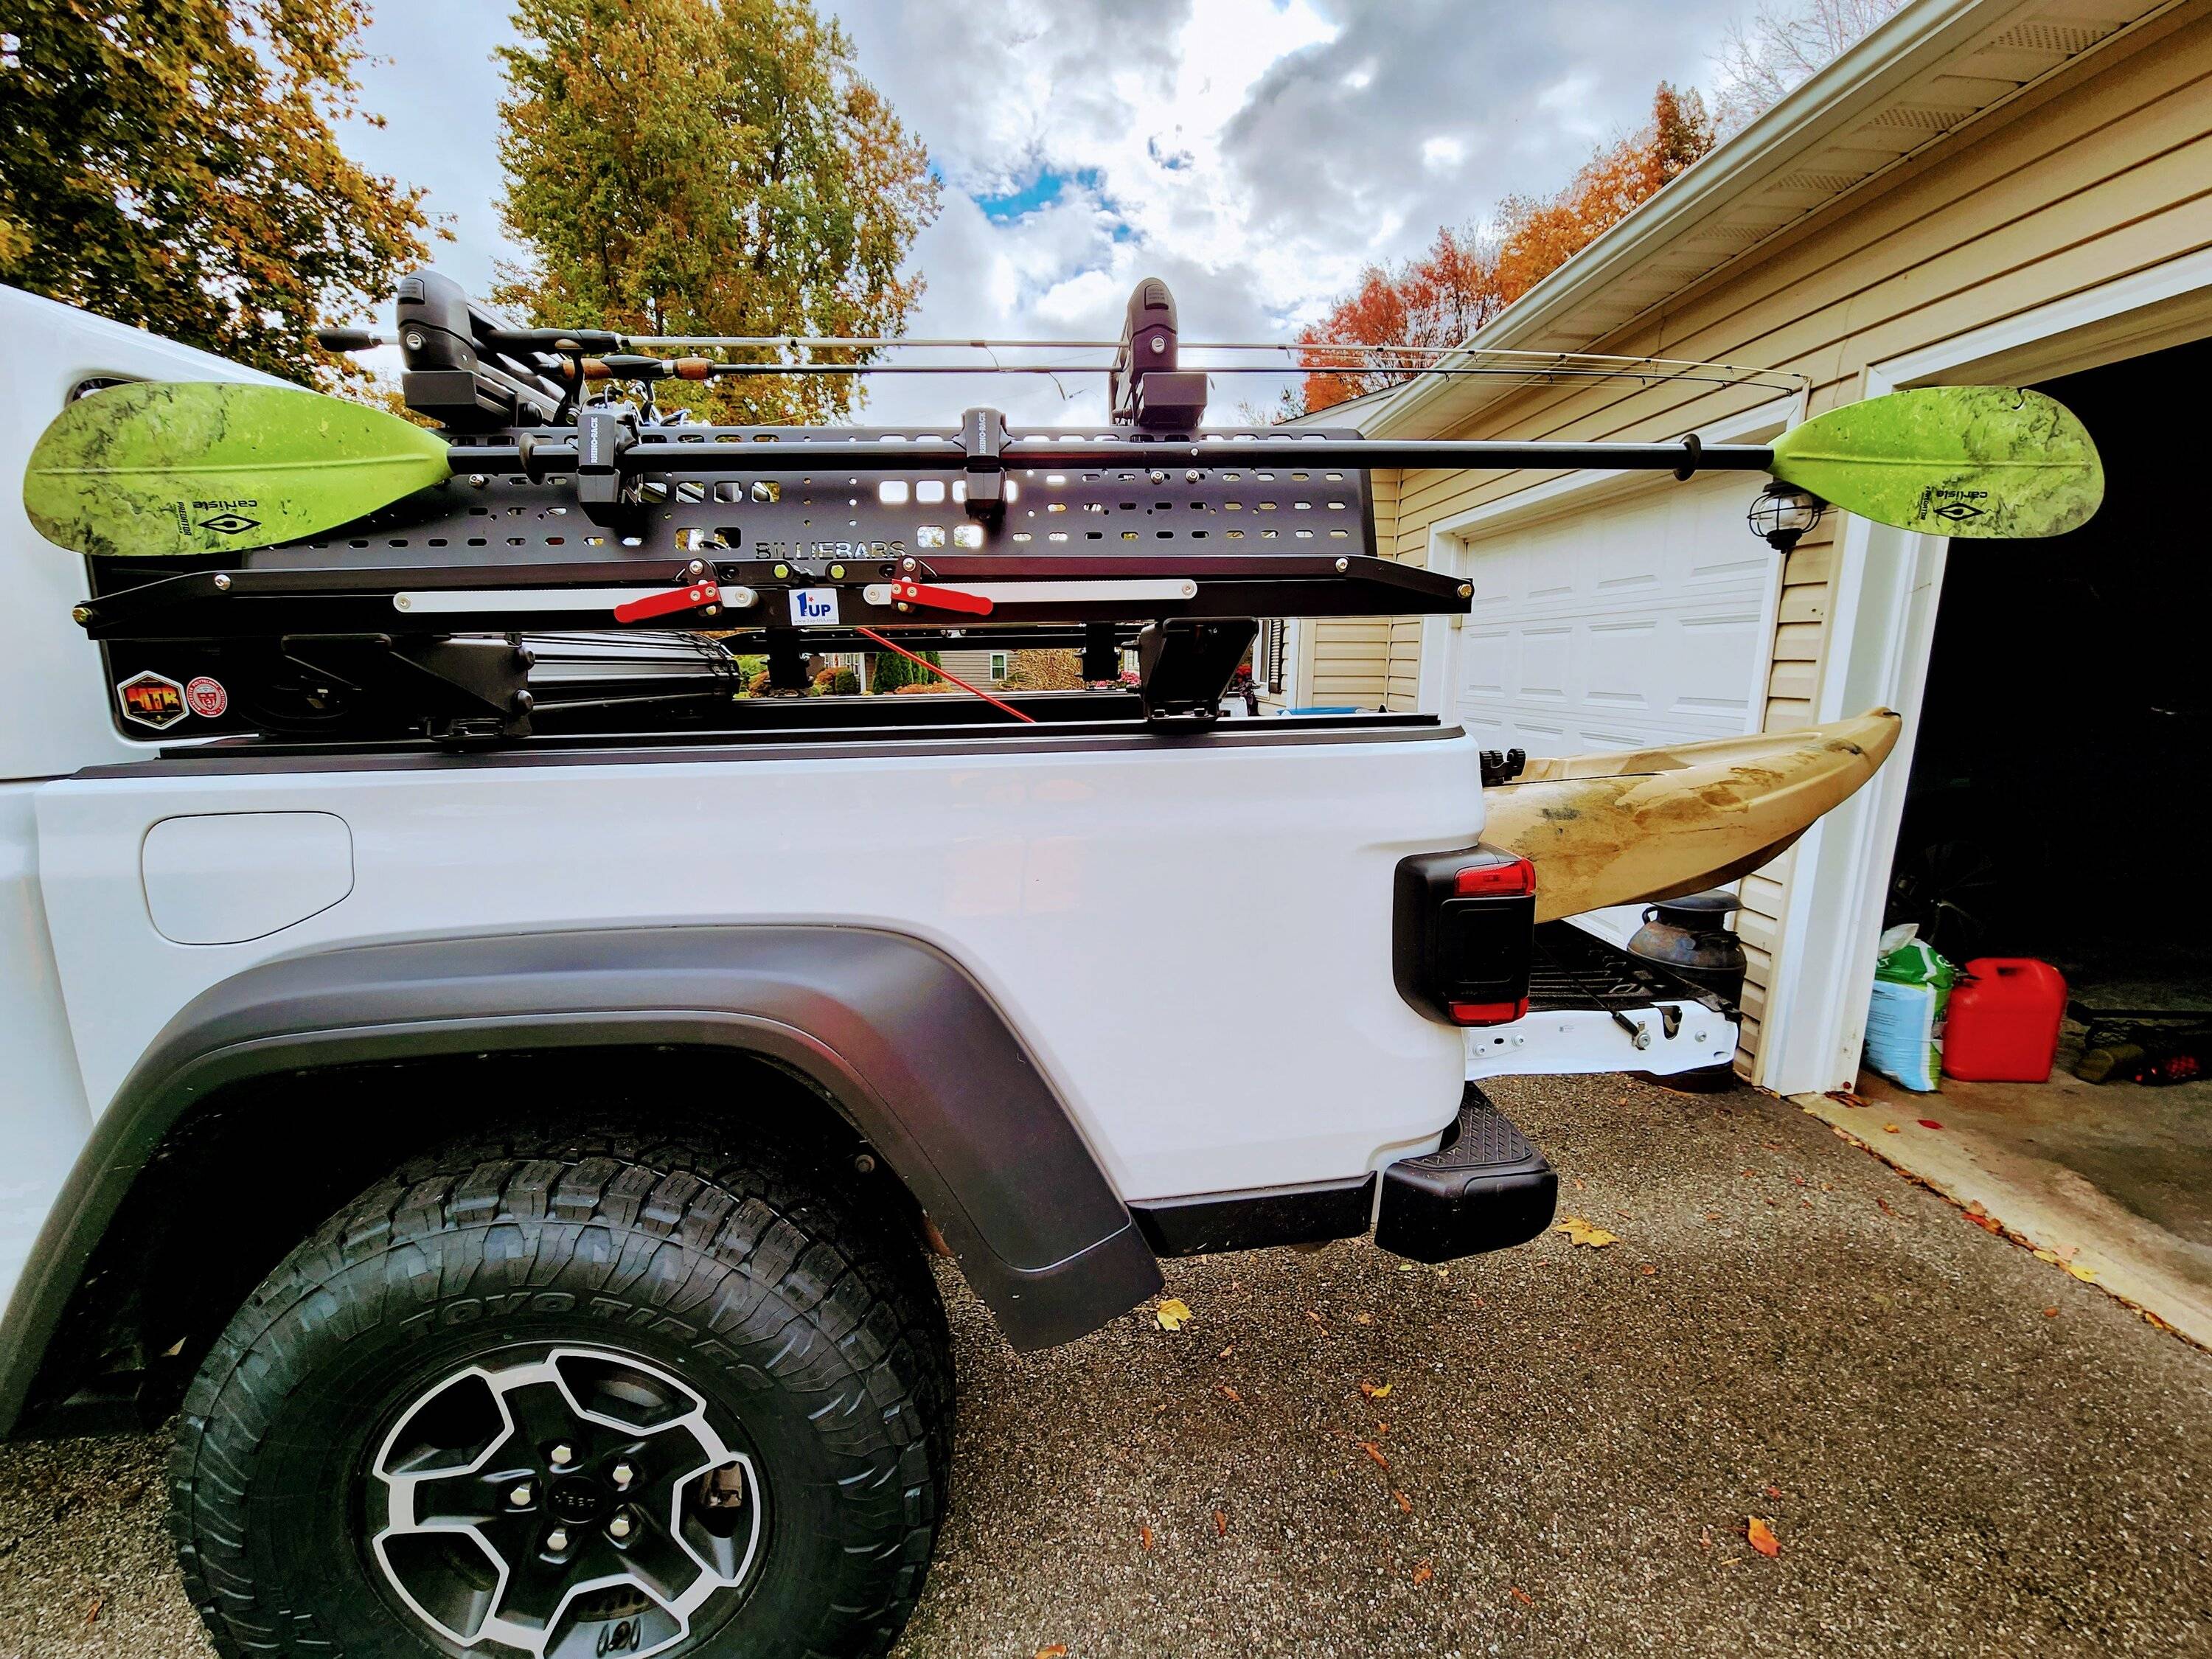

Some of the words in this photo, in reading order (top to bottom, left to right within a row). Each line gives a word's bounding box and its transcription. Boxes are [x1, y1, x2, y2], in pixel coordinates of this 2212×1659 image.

[590, 417, 598, 464] RHINO-RACK
[978, 411, 987, 454] RHINO-RACK
[177, 501, 192, 536] PREDATOR
[755, 540, 906, 560] BILLIEBARS
[192, 679, 219, 689] POLYTECHNIC
[398, 1291, 577, 1336] TOYO
